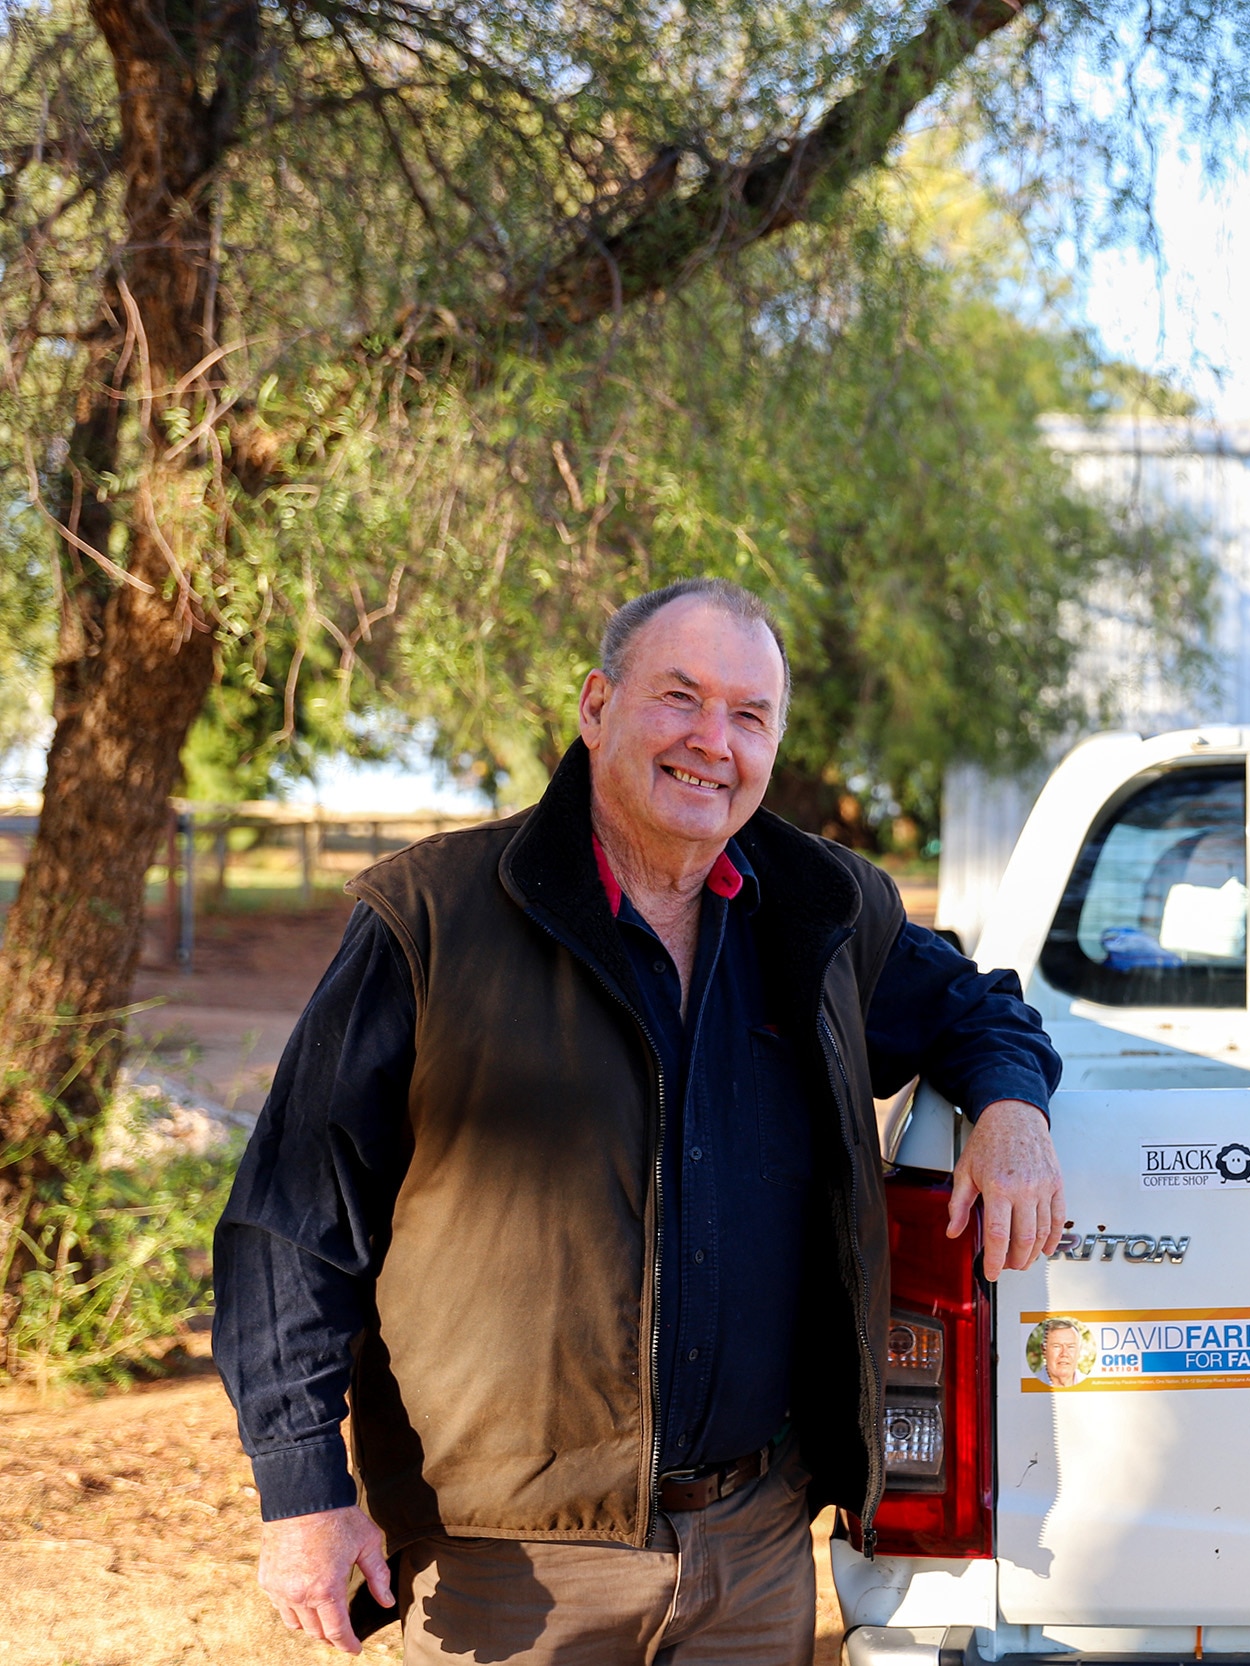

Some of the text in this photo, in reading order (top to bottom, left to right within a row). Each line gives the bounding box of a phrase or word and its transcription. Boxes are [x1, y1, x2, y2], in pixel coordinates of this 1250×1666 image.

[1146, 1149, 1214, 1171] BLACK
[1143, 1175, 1180, 1187] COFFEE
[1182, 1175, 1209, 1186] SHOP
[1042, 1233, 1190, 1264] RITON
[1101, 1353, 1139, 1367] one
[1185, 1352, 1223, 1369] FOR
